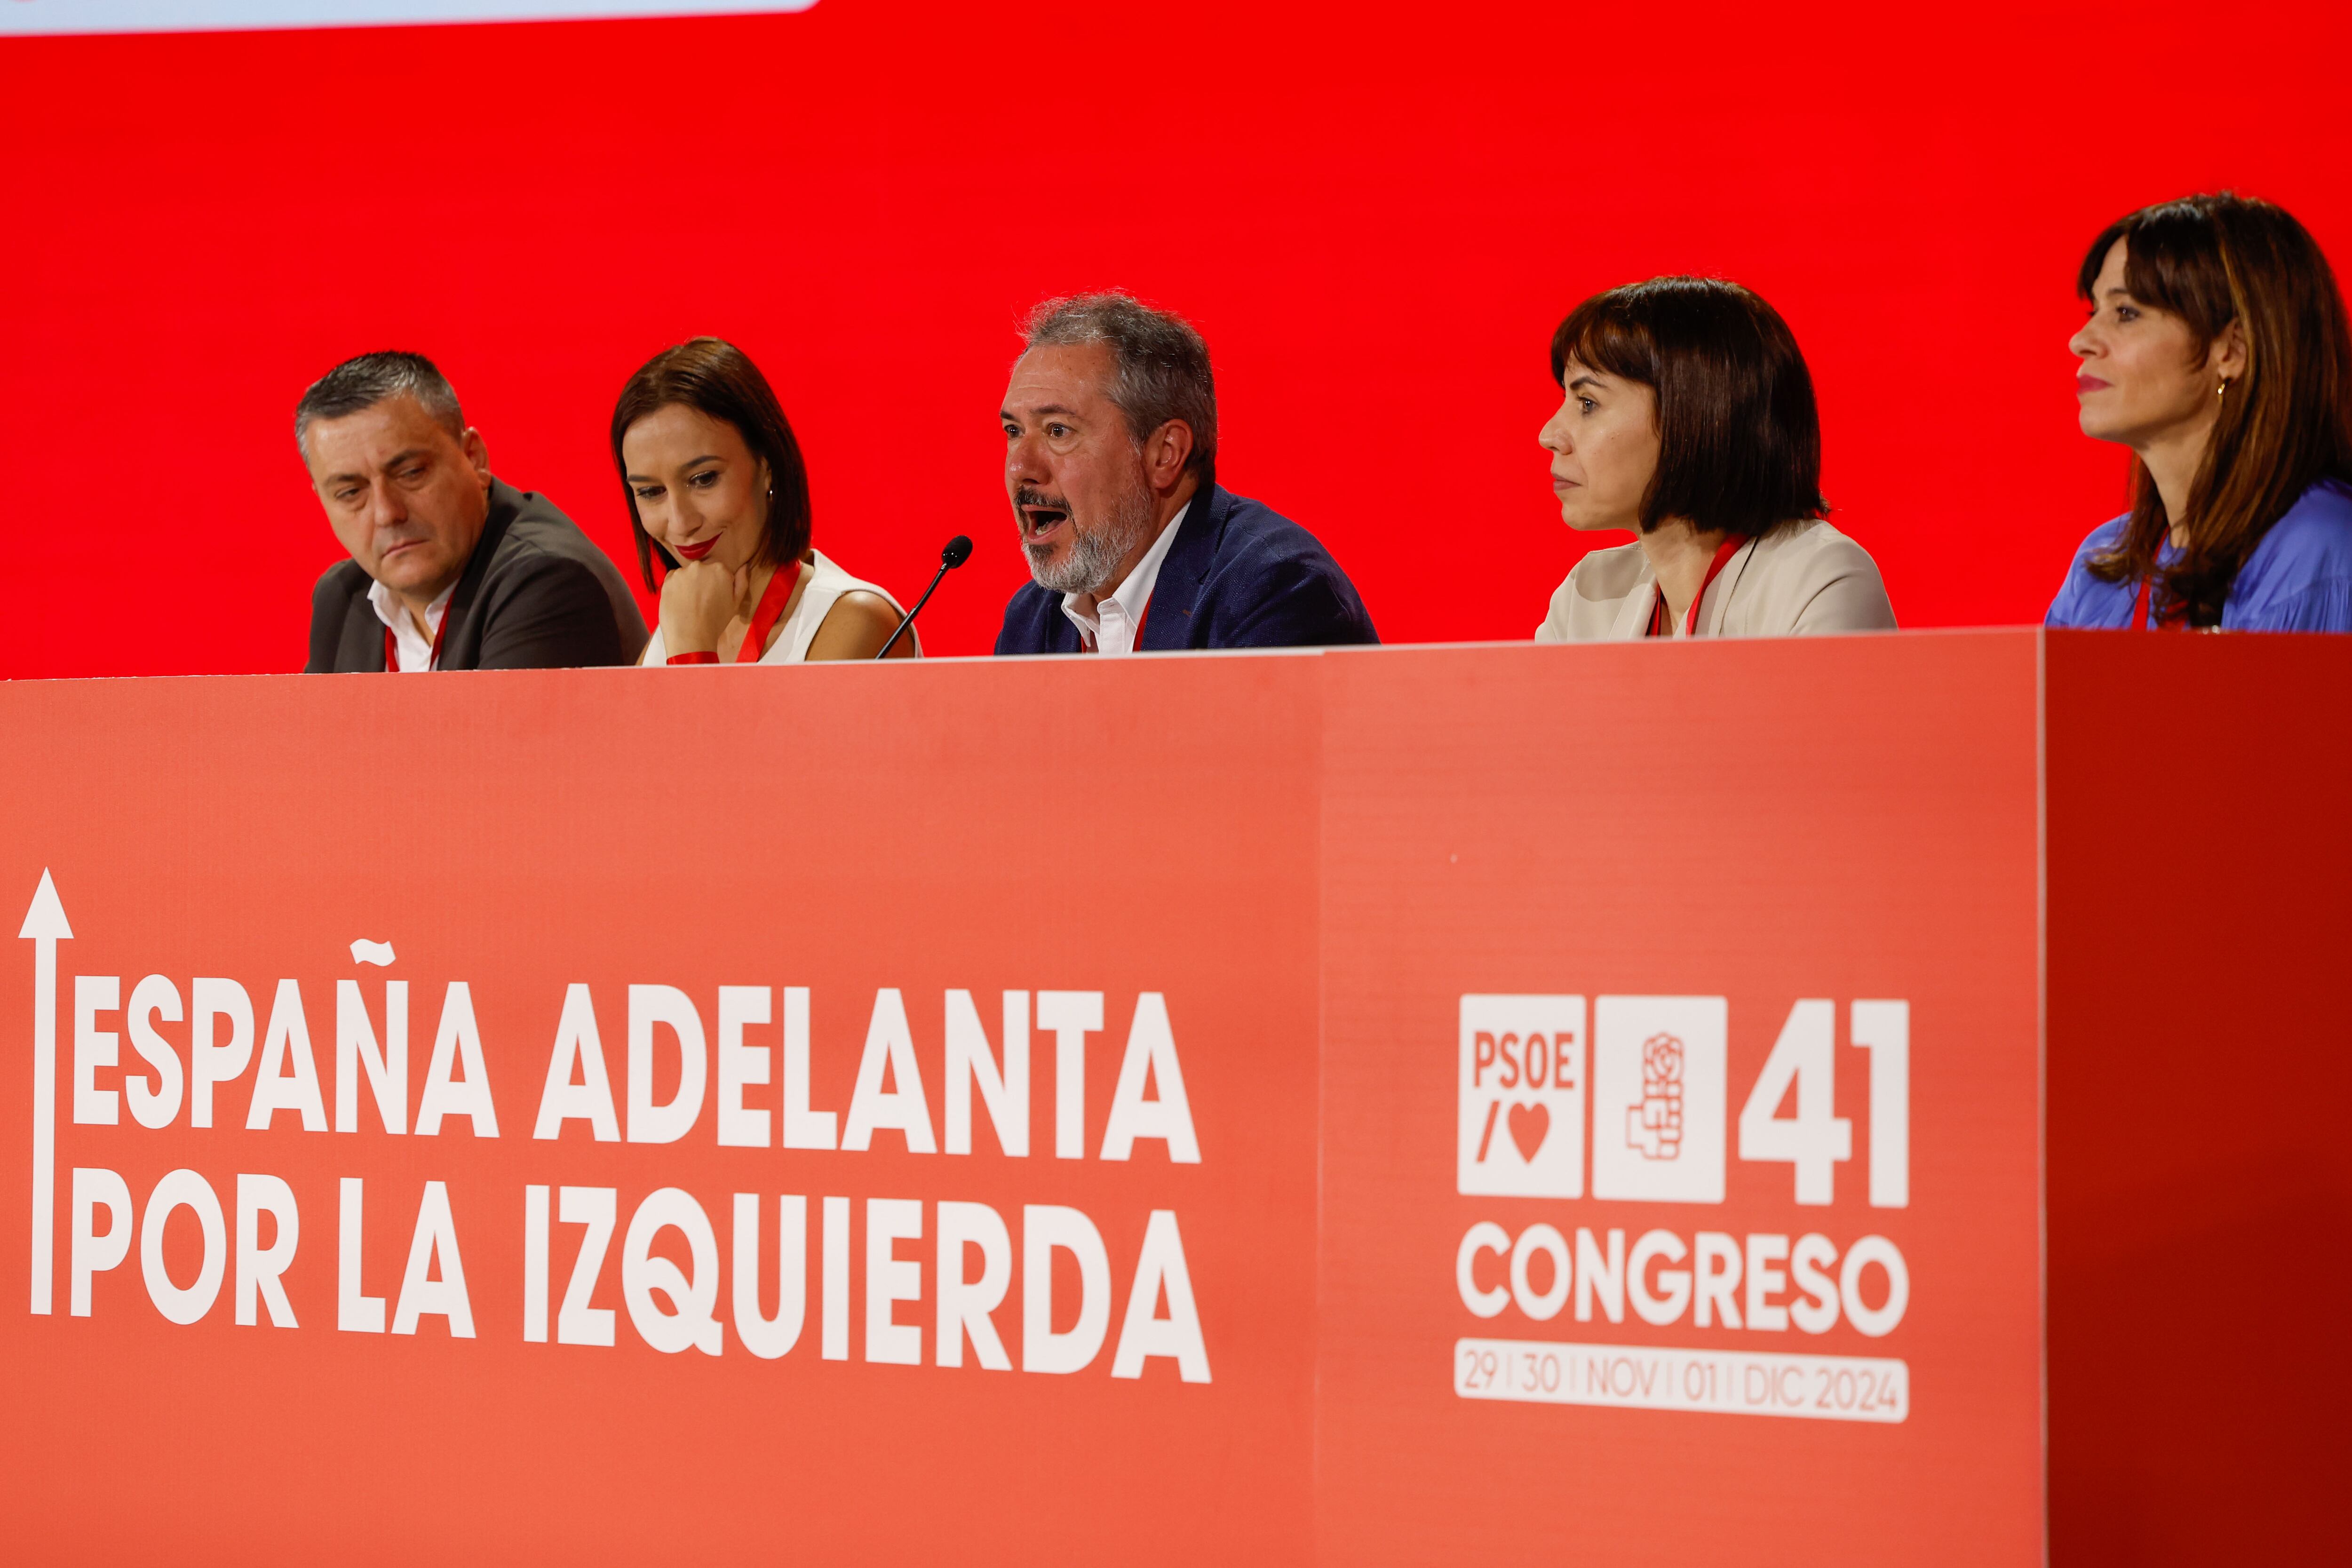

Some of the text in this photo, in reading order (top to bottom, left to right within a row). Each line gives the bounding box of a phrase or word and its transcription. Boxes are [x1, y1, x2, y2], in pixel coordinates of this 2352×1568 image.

[73, 939, 1201, 1163] ESPAÑA ADELANTA
[1474, 1031, 1573, 1090] PSOE
[1739, 999, 1909, 1208] 41
[71, 1168, 1212, 1384] POR LA IZQUIERDA
[1456, 1221, 1909, 1336] CONGRESO
[1463, 1350, 1897, 1412] 29 30 NOV 01 DIC 2024
